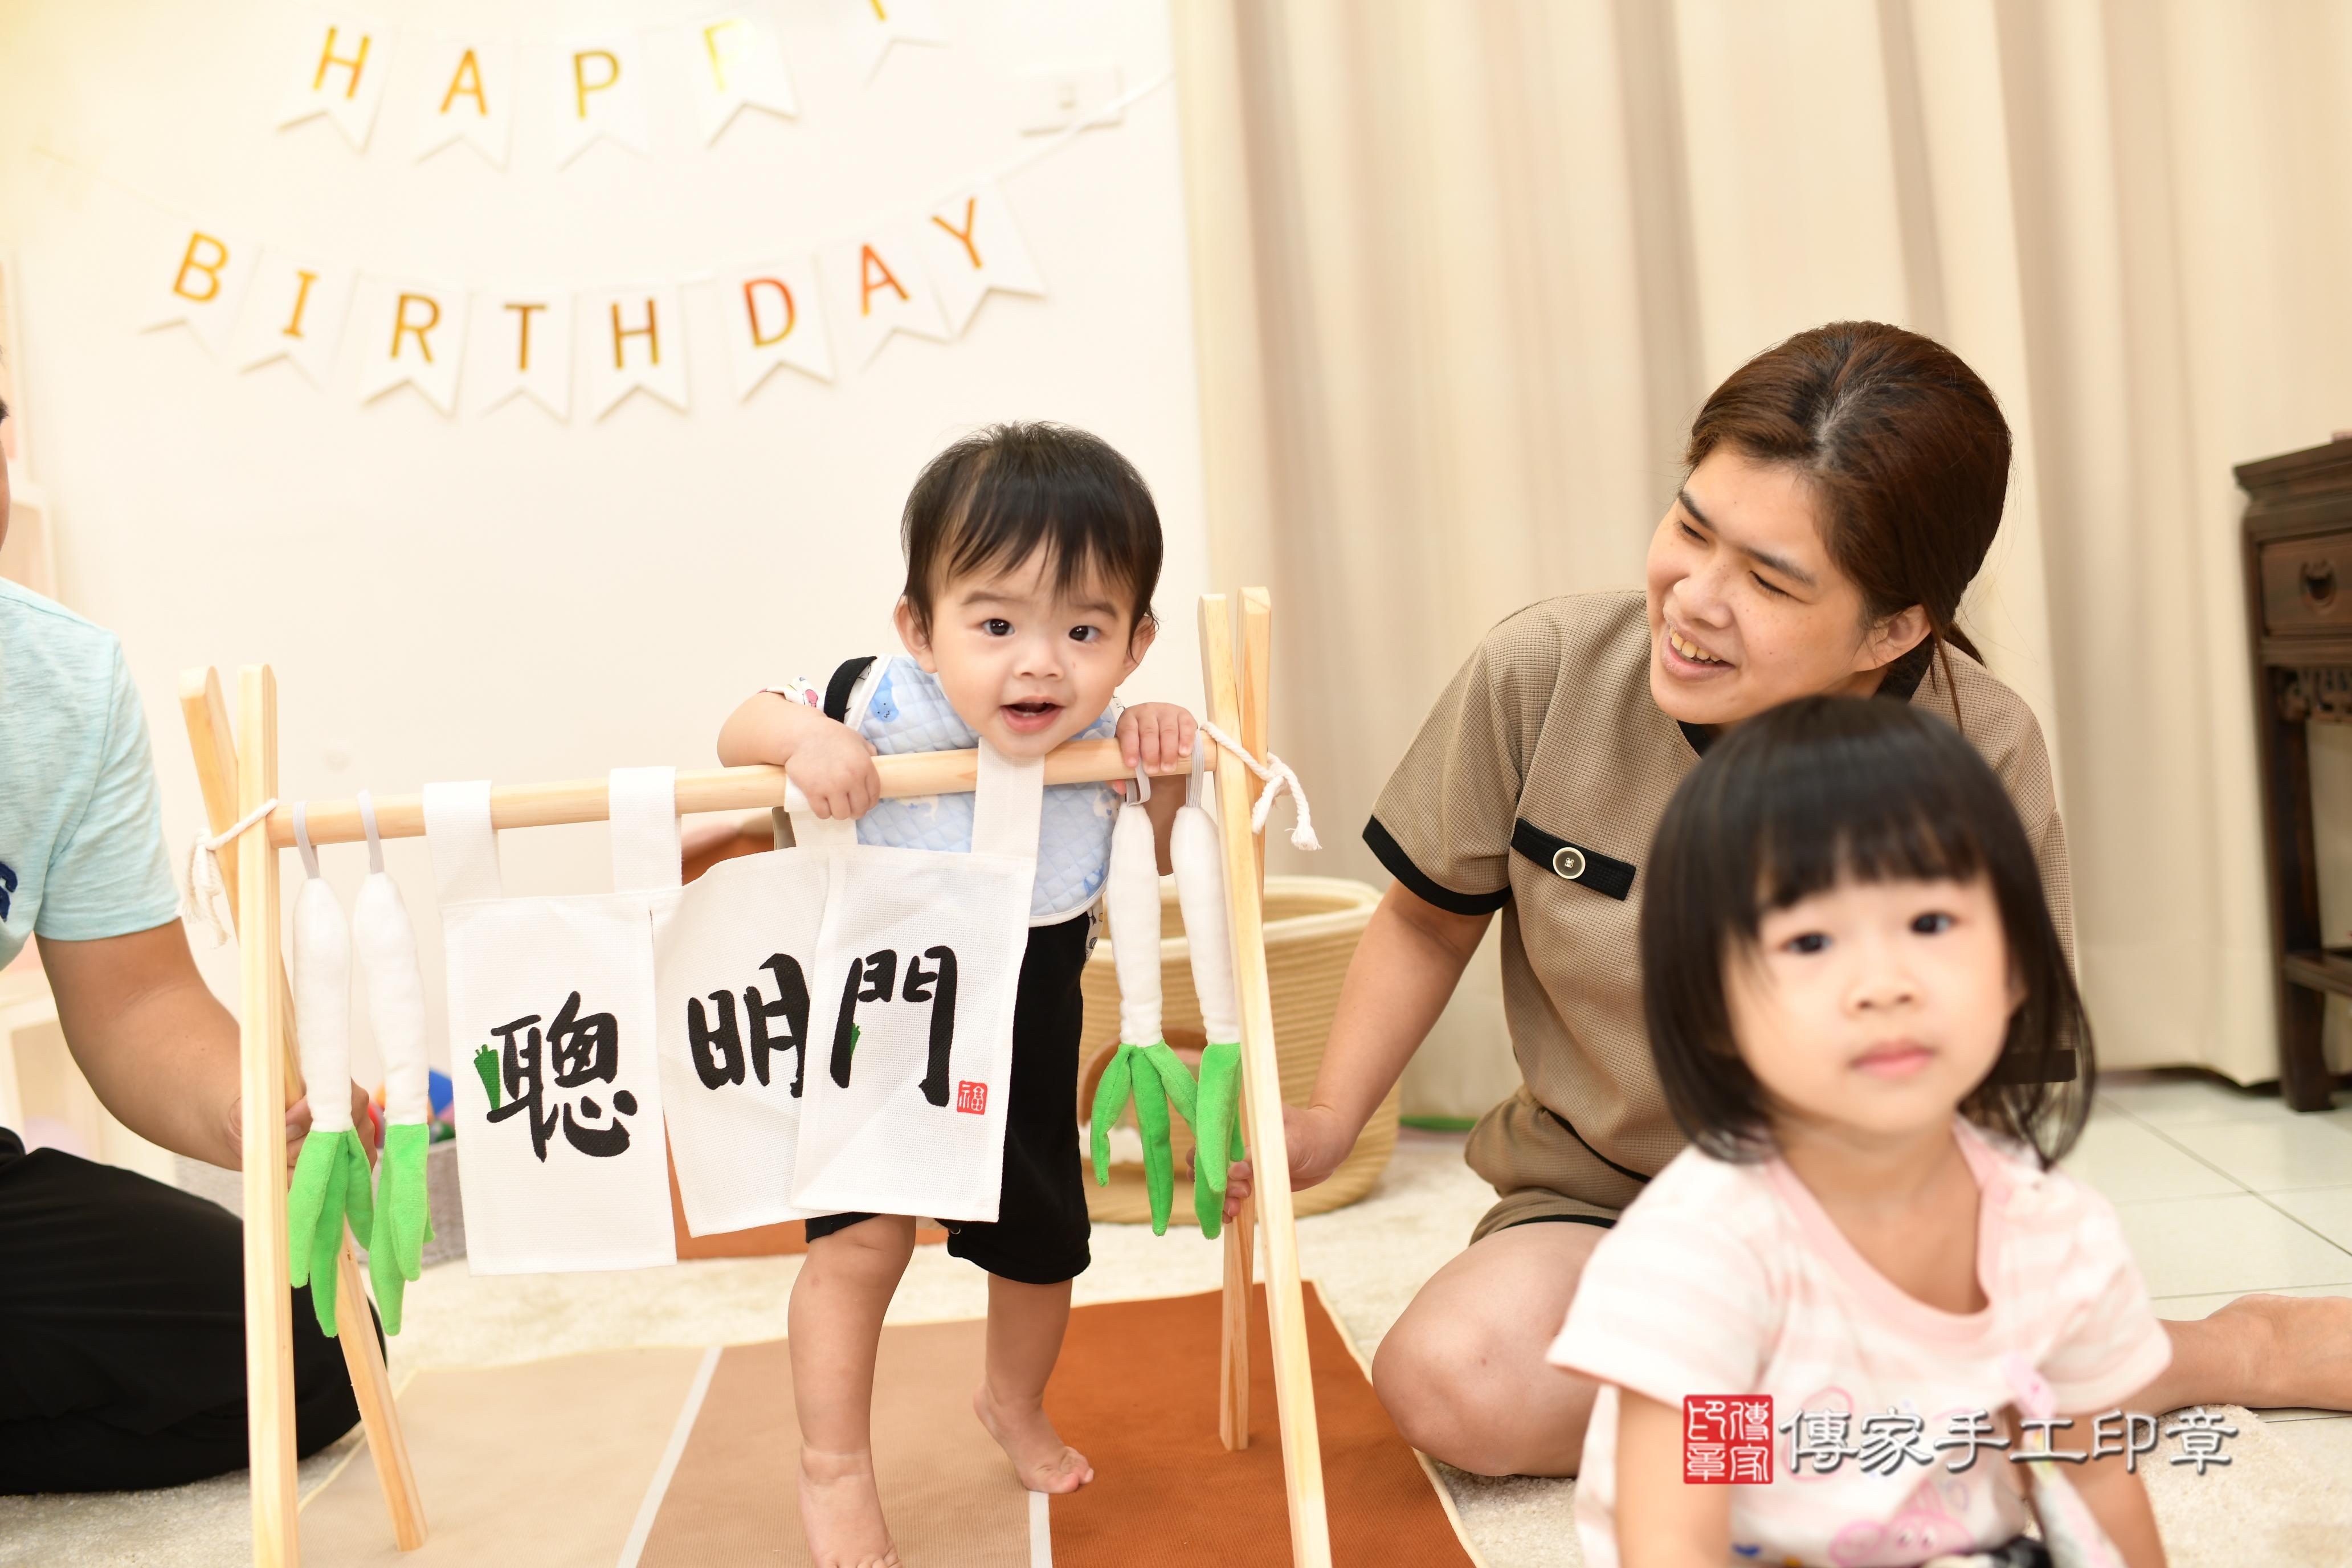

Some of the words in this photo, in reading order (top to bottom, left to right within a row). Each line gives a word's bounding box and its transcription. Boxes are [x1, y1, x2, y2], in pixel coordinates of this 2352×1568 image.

[312, 0, 889, 120] HAPP
[172, 196, 987, 372] BIRTHDAY
[958, 1083, 986, 1112] 福
